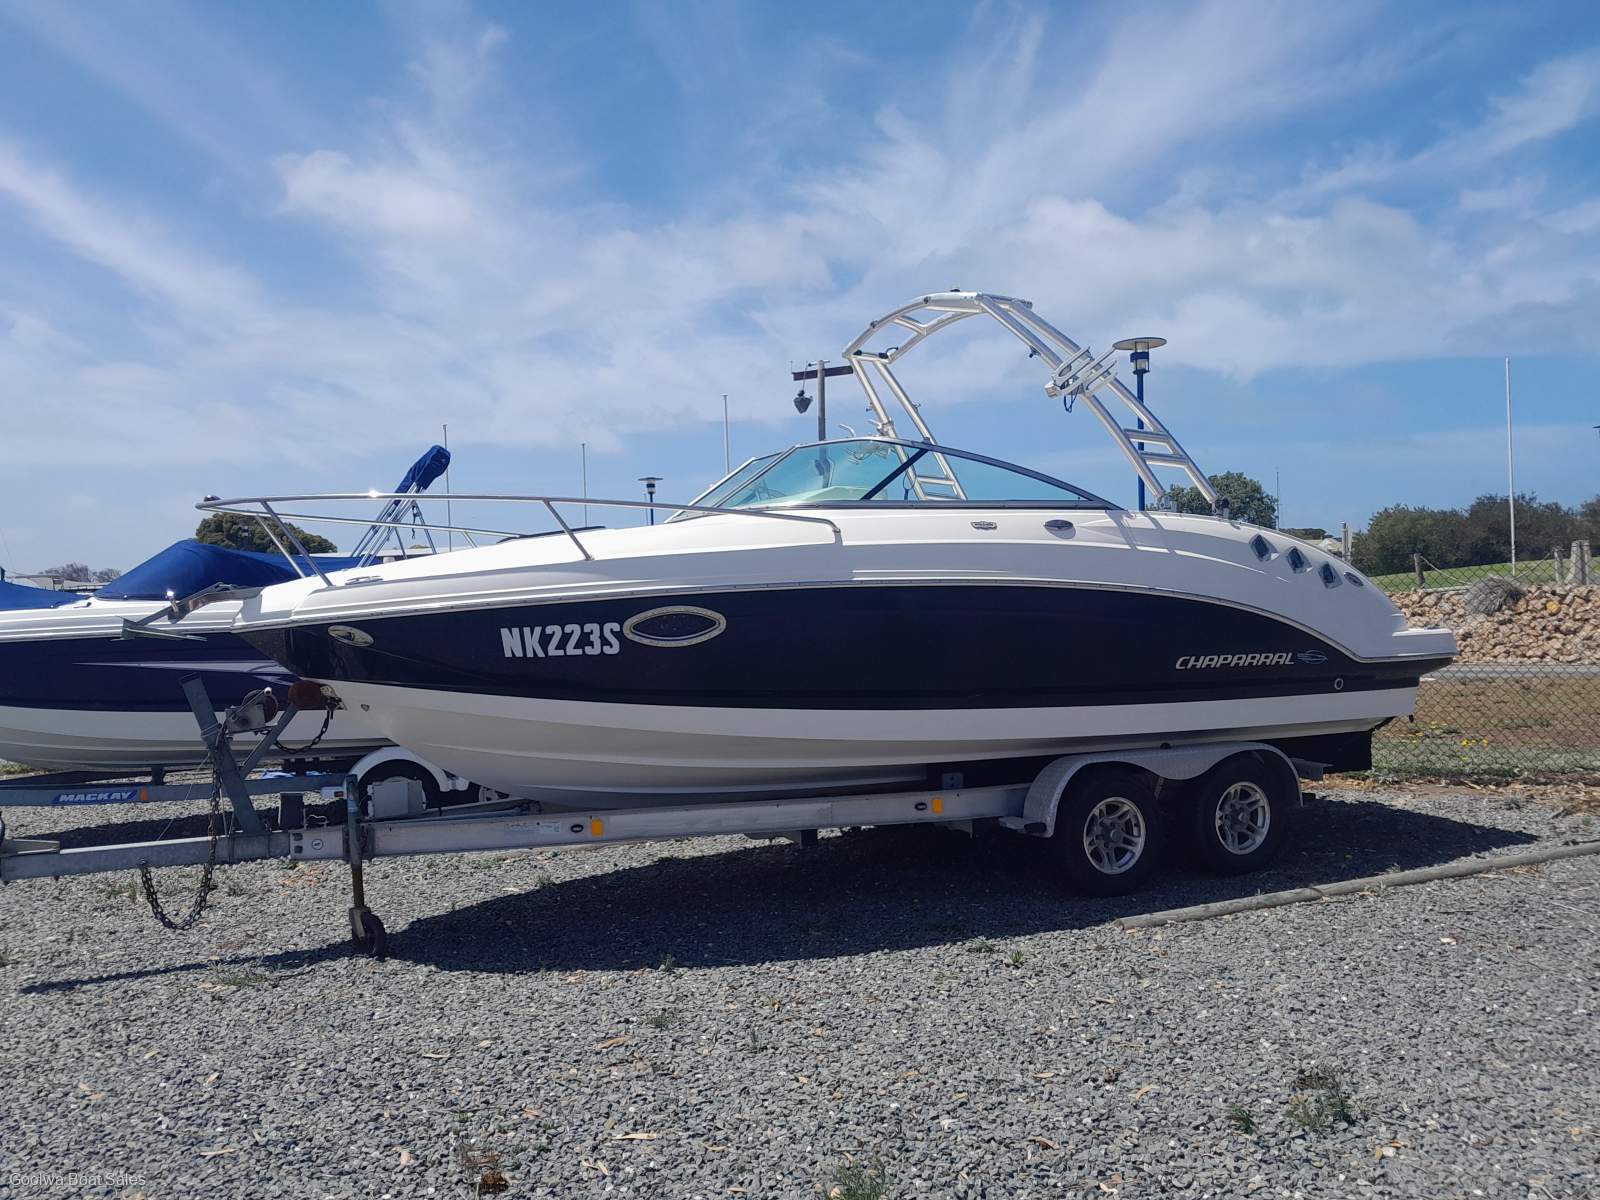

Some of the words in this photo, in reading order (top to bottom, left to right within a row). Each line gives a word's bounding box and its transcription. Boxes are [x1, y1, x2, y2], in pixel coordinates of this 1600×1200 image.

[501, 622, 620, 658] NK223S
[1175, 652, 1294, 670] CHAPARRAL
[59, 791, 132, 802] MACKAY
